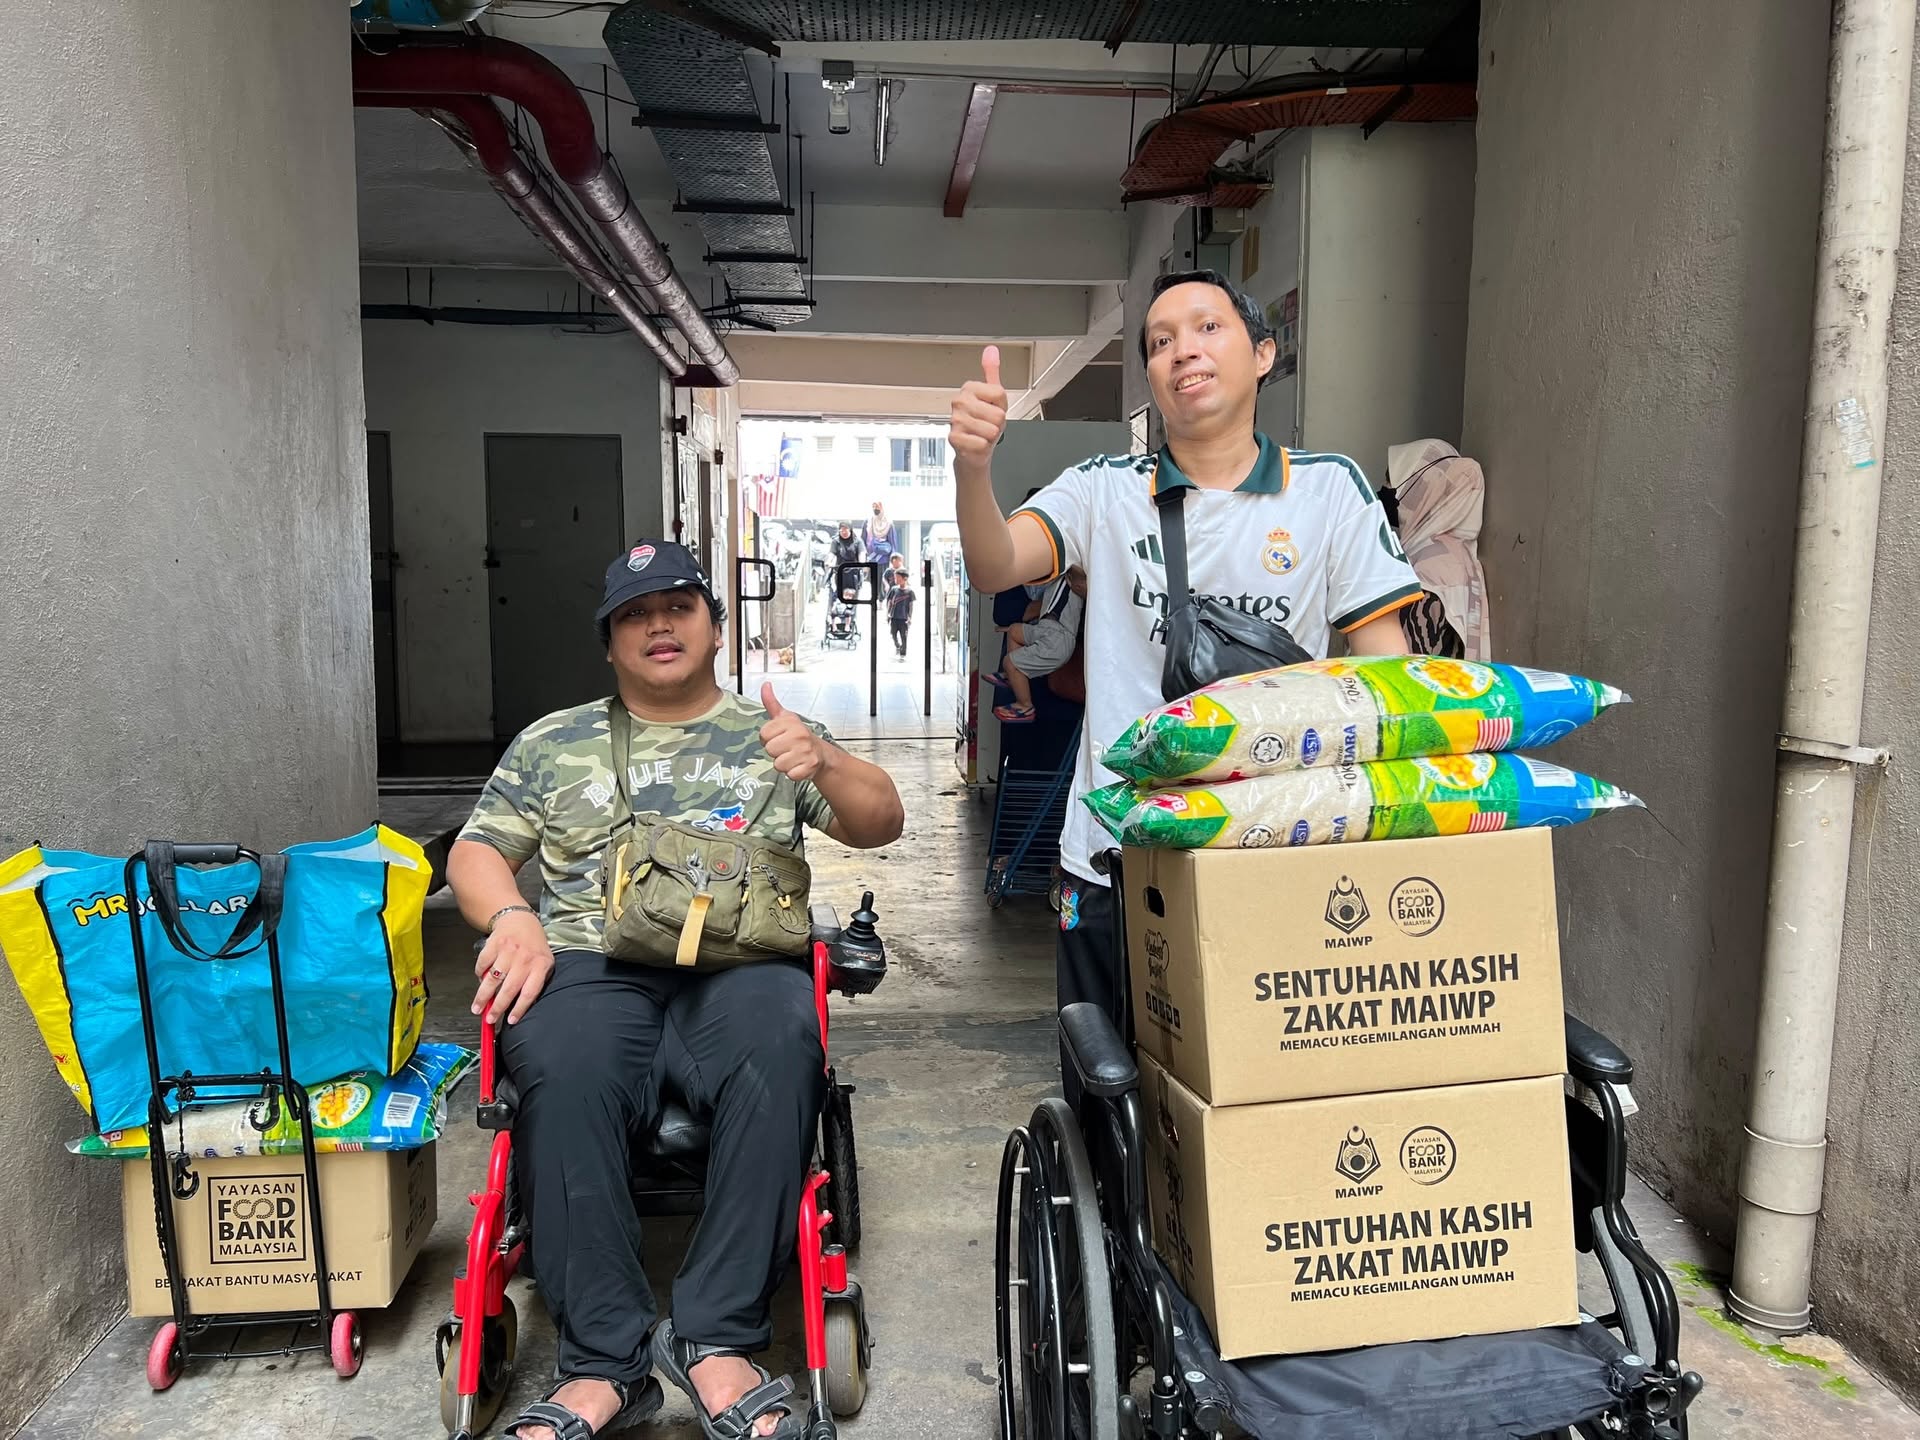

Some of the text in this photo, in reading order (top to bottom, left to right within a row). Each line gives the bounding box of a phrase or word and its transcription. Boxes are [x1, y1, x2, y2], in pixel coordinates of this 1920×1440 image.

[1133, 573, 1291, 623] Emates
[1343, 724, 1357, 763] UARA
[683, 757, 761, 802] JAYS
[1401, 887, 1430, 895] YAYASAN
[1397, 895, 1434, 909] FOOD
[1398, 907, 1436, 920] BANK
[1403, 919, 1432, 927] MALAYSIA
[1324, 935, 1374, 949] MAIWP
[1254, 953, 1519, 1002] SENTUHAN KASIH
[1283, 990, 1496, 1035] ZAKAT MAIWP
[1280, 1022, 1501, 1051] MEMACU KEGEMILANGAN UMMAH
[1412, 1136, 1441, 1144] YAYASAN
[1408, 1144, 1446, 1158] FOOD
[1409, 1155, 1447, 1168] BANK
[217, 1183, 296, 1196] YAYASAN
[1335, 1185, 1384, 1199] MAIWP
[217, 1197, 296, 1221] FOOD
[218, 1219, 296, 1241] BANK
[1264, 1201, 1533, 1252] SENTUHAN KASIH
[219, 1242, 297, 1256] MALAYSIA
[1294, 1238, 1509, 1285] ZAKAT MAIWP
[155, 1270, 363, 1289] BEAKAT BANTU MASYAAKAT
[1290, 1271, 1515, 1302] MEMACU KEGEMILANGAN UMMAH
